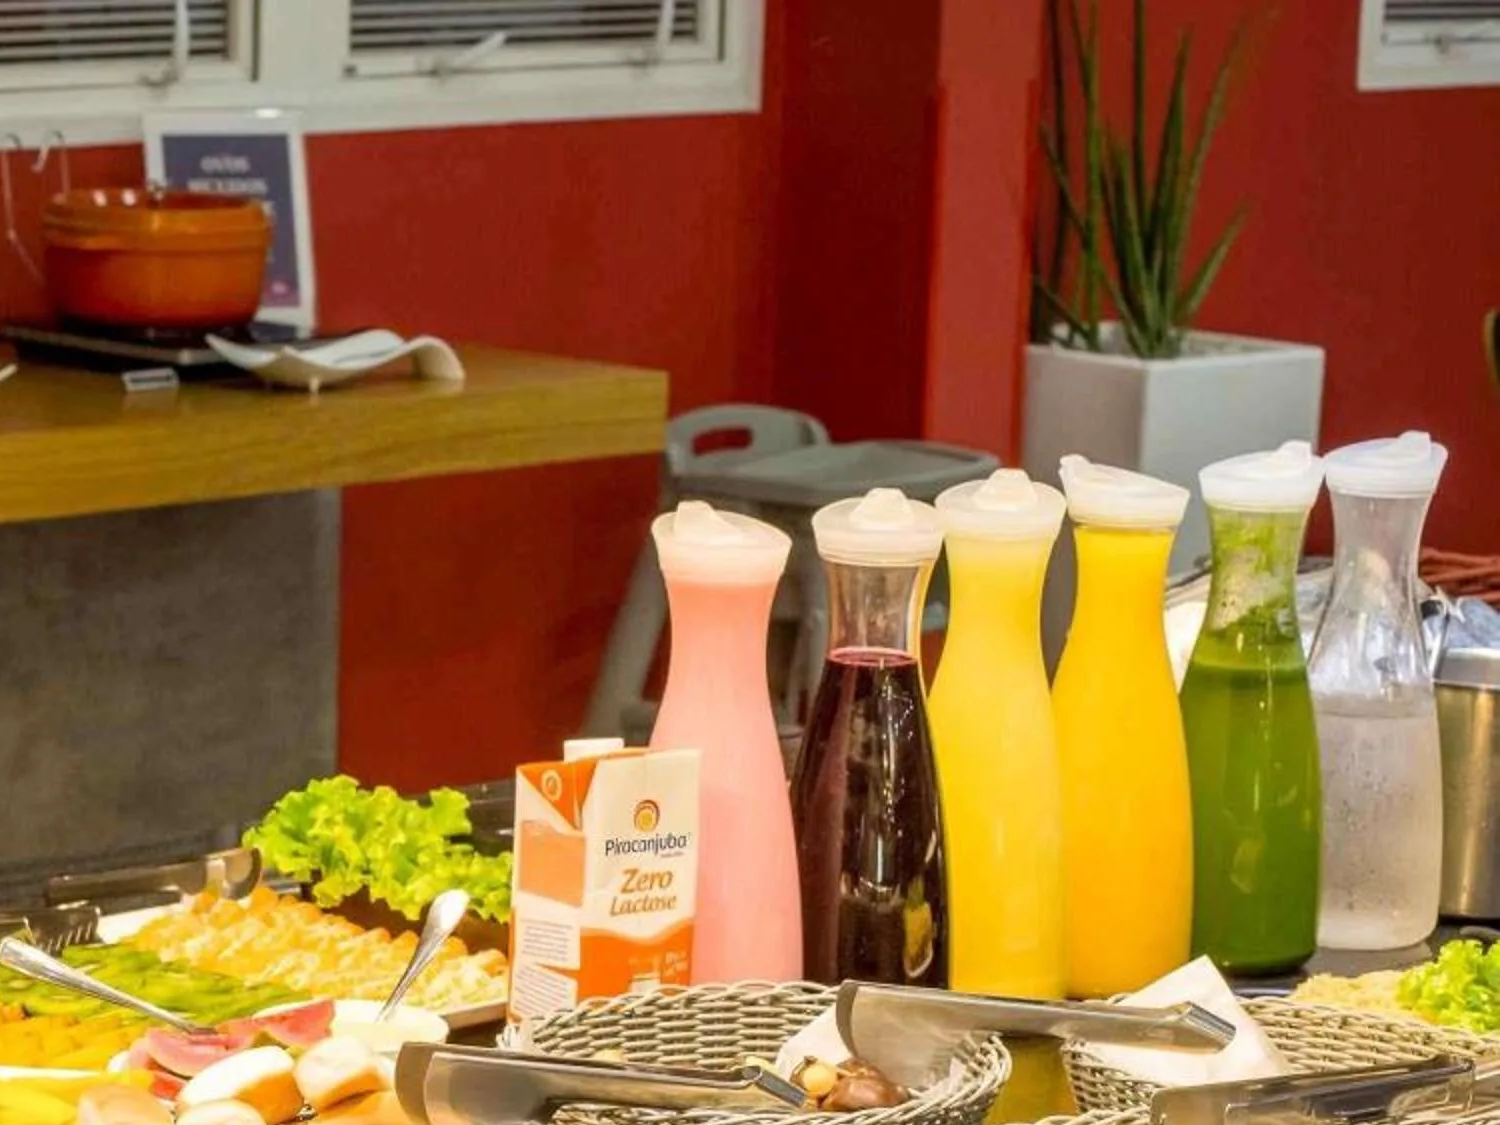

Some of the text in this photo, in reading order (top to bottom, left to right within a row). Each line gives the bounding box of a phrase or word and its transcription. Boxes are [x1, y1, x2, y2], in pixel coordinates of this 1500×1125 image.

[604, 833, 688, 857] Piracanjuba
[620, 868, 674, 894] Zero
[609, 895, 677, 917] Lactose
